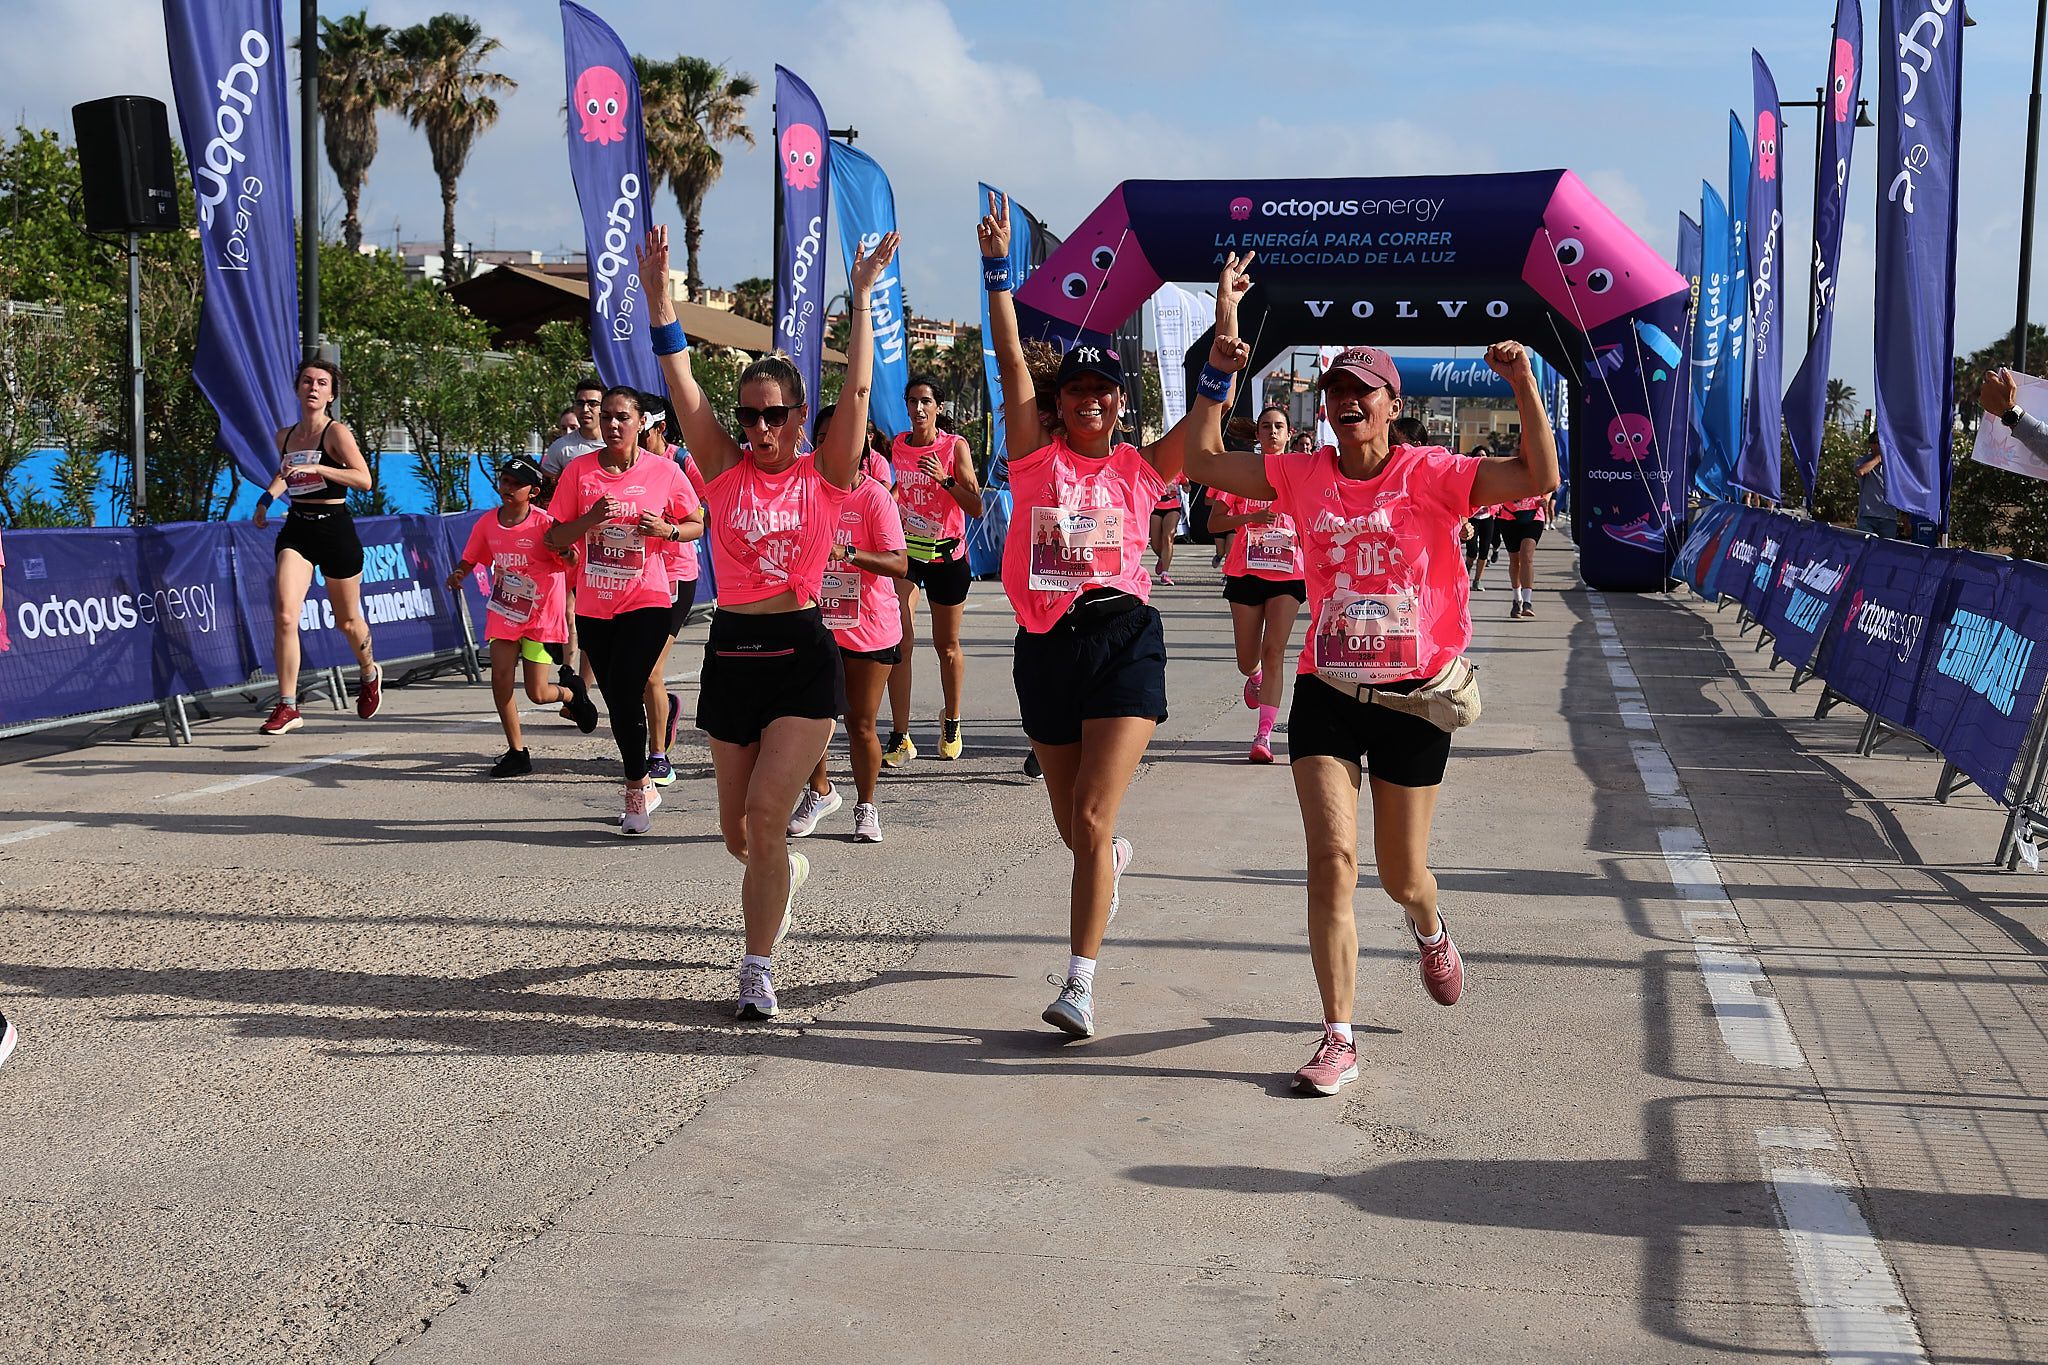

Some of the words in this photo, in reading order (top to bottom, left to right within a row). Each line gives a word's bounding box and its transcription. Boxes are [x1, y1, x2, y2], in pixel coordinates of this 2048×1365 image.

[1262, 198, 1358, 221] octopus
[1360, 197, 1445, 222] energy
[1214, 233, 1236, 247] LA
[1241, 230, 1319, 248] ENERGÍA
[1324, 233, 1373, 247] PARA
[1378, 231, 1452, 246] CORRER
[1258, 252, 1360, 265] VELOCIDAD
[1364, 252, 1388, 264] DE
[1393, 252, 1416, 264] LA
[1421, 251, 1456, 264] LUZ
[1304, 300, 1509, 318] VOLVO
[1588, 469, 1632, 482] octopus
[1632, 469, 1673, 485] energy
[603, 547, 626, 558] 016
[1062, 546, 1094, 561] 016
[1263, 546, 1282, 555] 016
[359, 542, 410, 584] HISPA
[1355, 542, 1386, 576] DE
[586, 574, 628, 591] MUJER
[1040, 579, 1069, 587] OYSHO
[364, 580, 436, 625] zancada
[501, 591, 518, 603] 016
[18, 594, 138, 645] octopus
[137, 583, 217, 633] energy
[1348, 606, 1386, 616] ASTURIANA
[1347, 635, 1387, 651] 016
